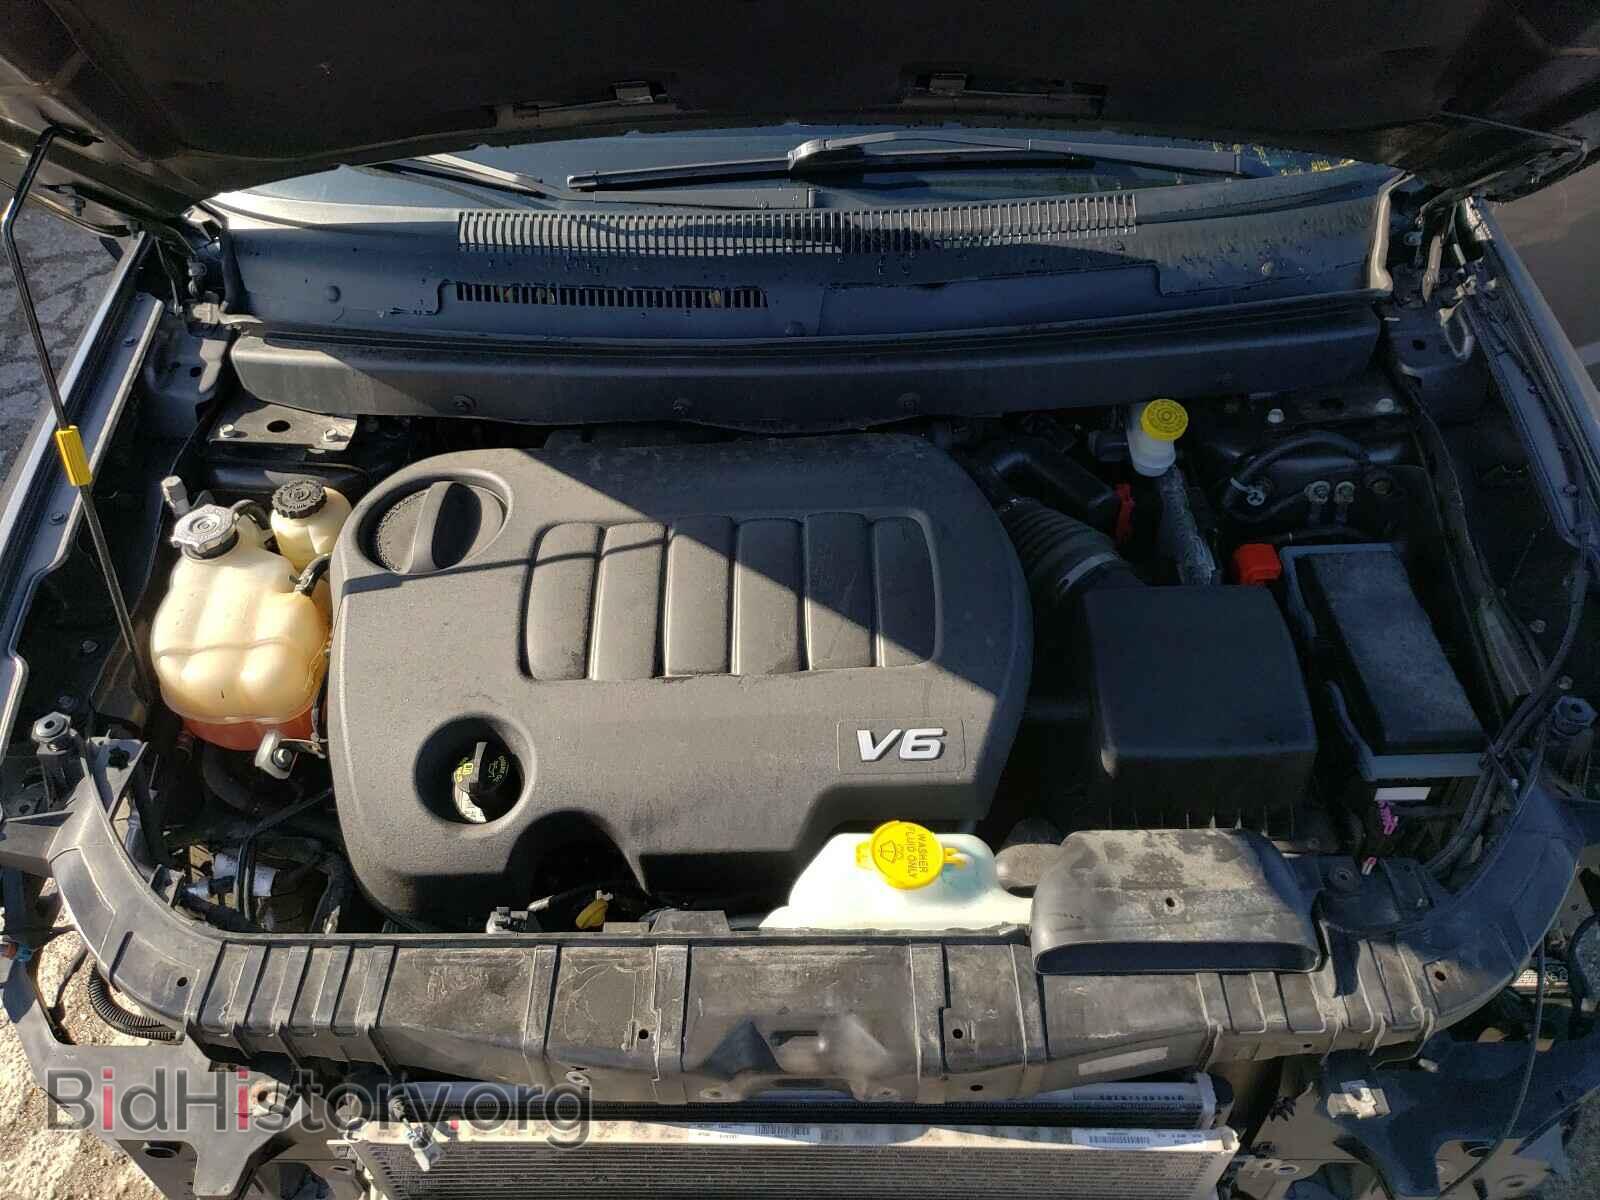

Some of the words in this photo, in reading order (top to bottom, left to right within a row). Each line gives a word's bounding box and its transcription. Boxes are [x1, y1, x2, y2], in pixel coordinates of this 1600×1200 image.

[857, 728, 945, 761] V6
[905, 826, 917, 852] FLUID
[918, 833, 928, 873] WASHER
[907, 855, 918, 879] ONLY
